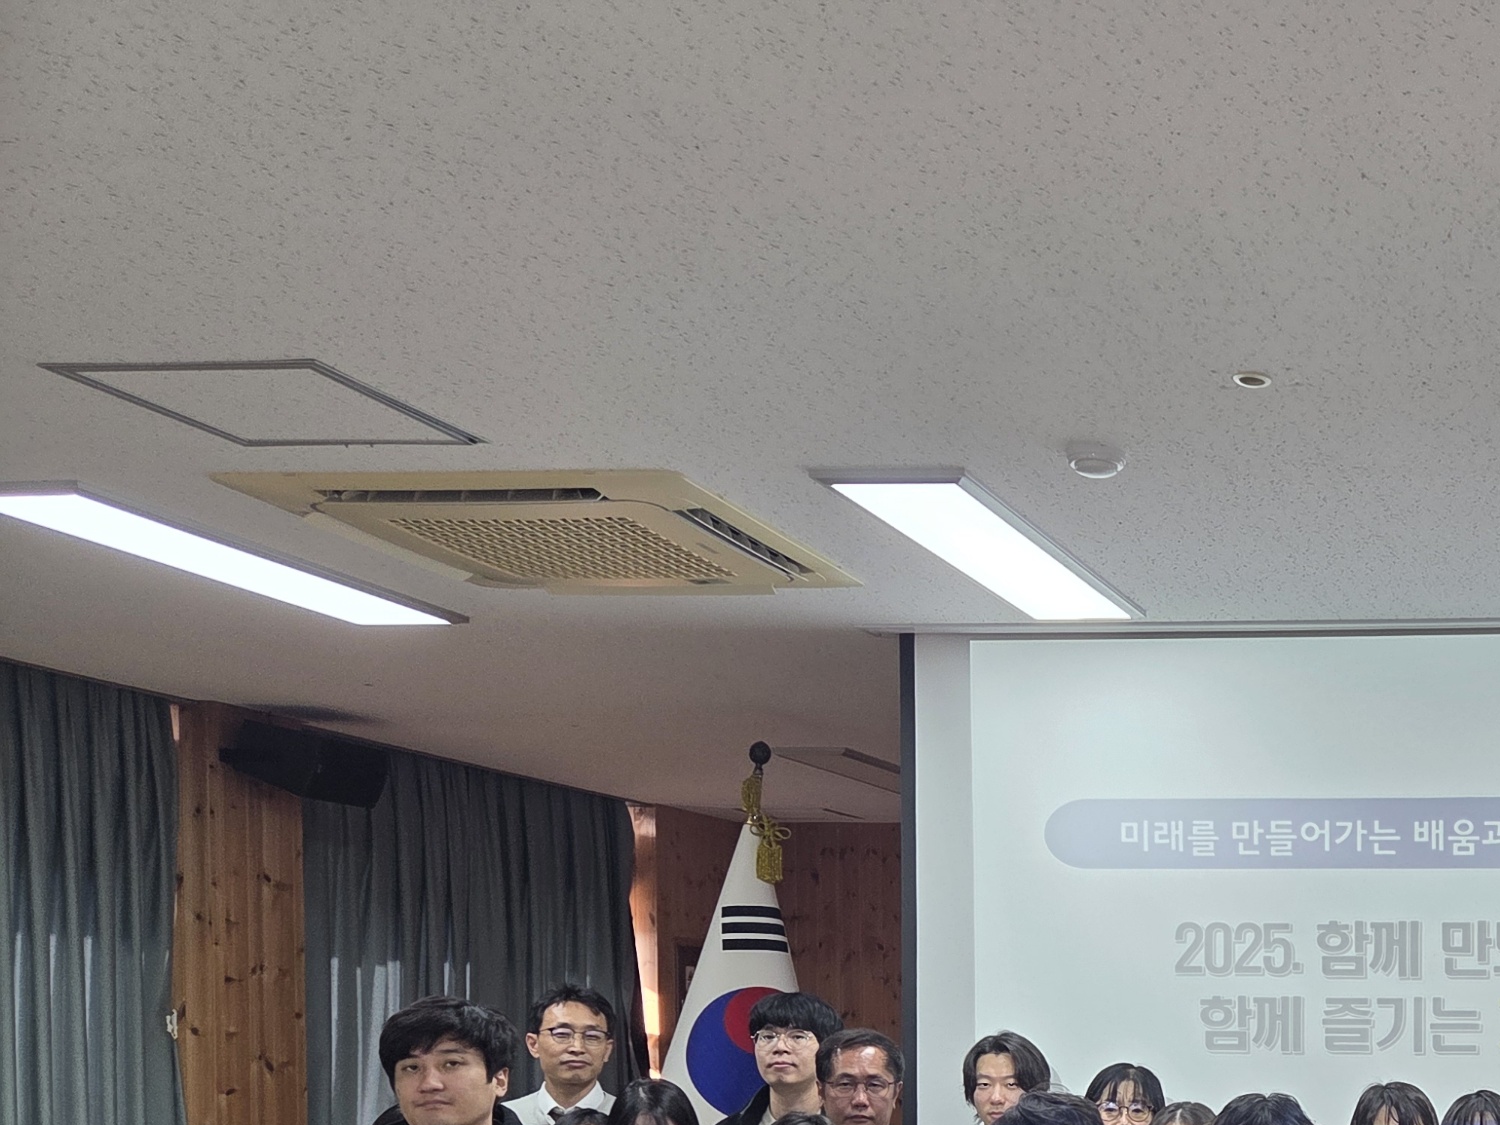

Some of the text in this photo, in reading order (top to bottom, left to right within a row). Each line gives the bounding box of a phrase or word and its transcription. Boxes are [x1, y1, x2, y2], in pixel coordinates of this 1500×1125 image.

[1120, 820, 1219, 854] 미래를
[1231, 819, 1400, 855] 만들어가는
[1174, 922, 1303, 977] 2025.
[1316, 922, 1422, 980] 함께
[1200, 997, 1305, 1054] 함께
[1321, 996, 1481, 1055] 즐기는
